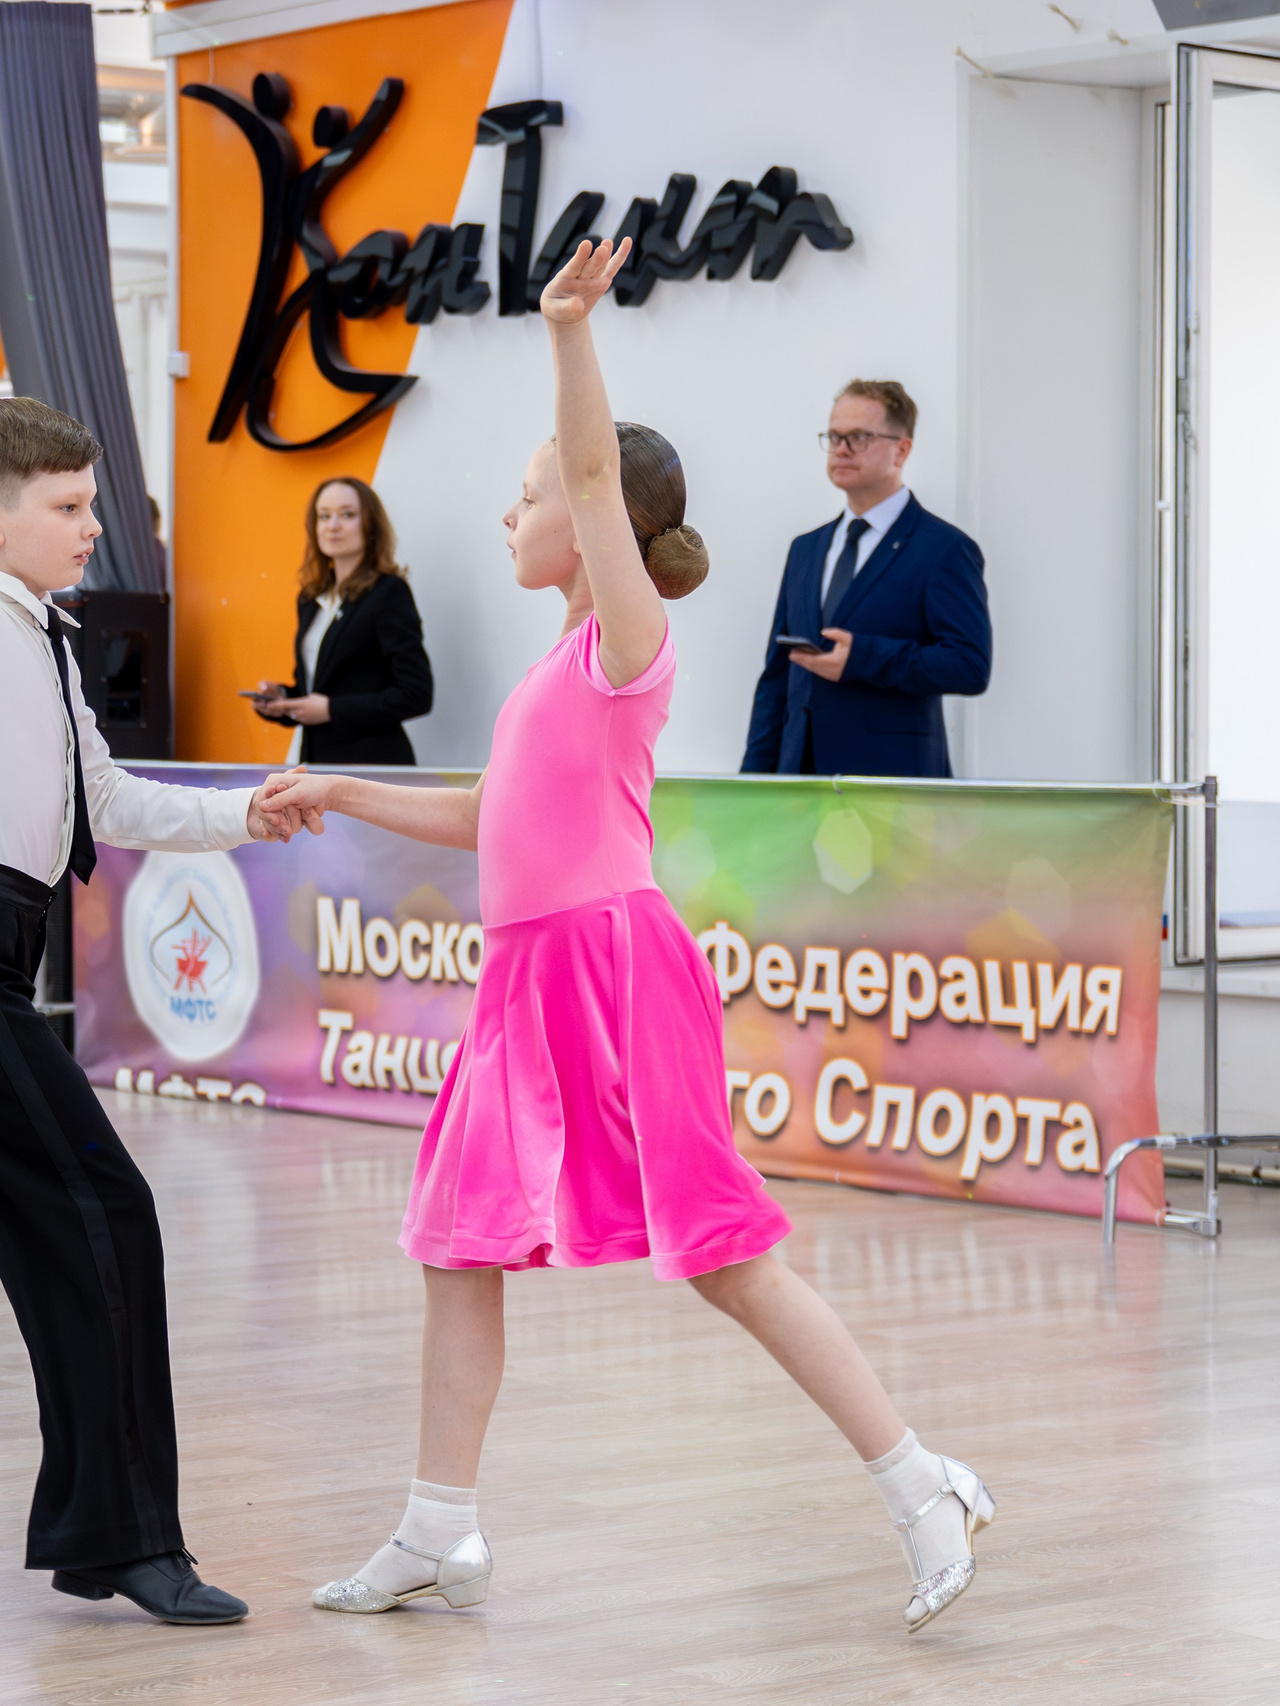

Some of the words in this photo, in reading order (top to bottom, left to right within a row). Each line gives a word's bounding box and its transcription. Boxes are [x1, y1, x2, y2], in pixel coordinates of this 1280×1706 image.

[317, 896, 484, 984] Моско
[697, 920, 1122, 1042] Федерация
[318, 1009, 459, 1094] Танц
[814, 1057, 1101, 1180] Спорта
